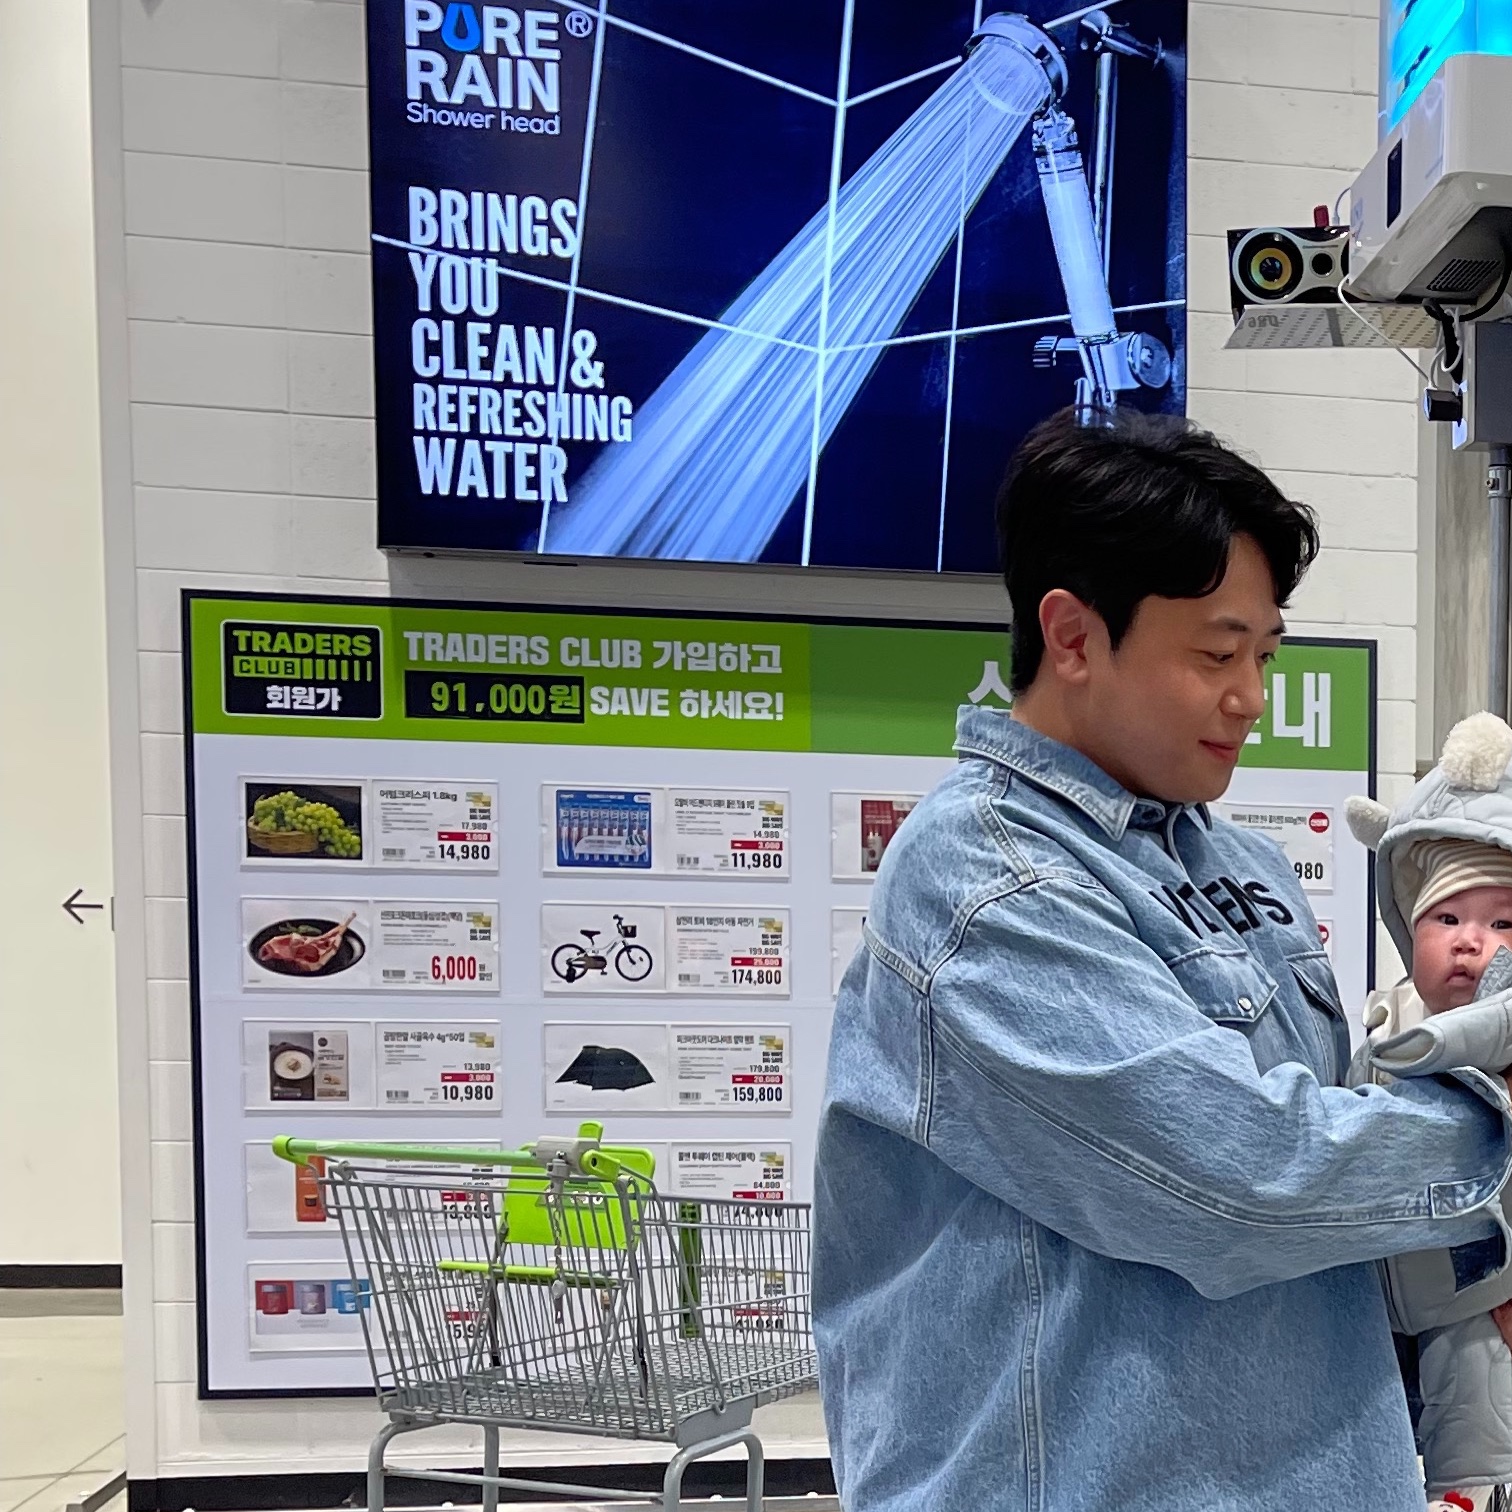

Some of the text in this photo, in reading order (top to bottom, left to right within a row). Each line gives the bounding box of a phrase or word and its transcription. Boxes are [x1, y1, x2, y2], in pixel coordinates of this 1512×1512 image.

[404, 0, 561, 60] PURE
[406, 48, 561, 112] RAIN
[406, 102, 560, 135] Shower head
[407, 186, 578, 259] BRINGS
[408, 252, 499, 317] YOU
[411, 318, 556, 385] CLEAN
[412, 382, 632, 443] REFRESHING
[412, 435, 568, 502] WATER
[232, 630, 373, 657] TRADERS
[403, 631, 782, 674] TRADERS CLUB 가입하고
[238, 658, 296, 675] CLUB
[266, 684, 341, 712] 회원가
[430, 681, 784, 721] 91,000원 SAVE 하세요!
[438, 844, 491, 861] 14,980
[731, 852, 783, 870] 11,980
[431, 955, 477, 984] 6,000
[731, 969, 782, 986] 174,800
[441, 1085, 494, 1102] 10,980
[732, 1086, 783, 1104] 159,800
